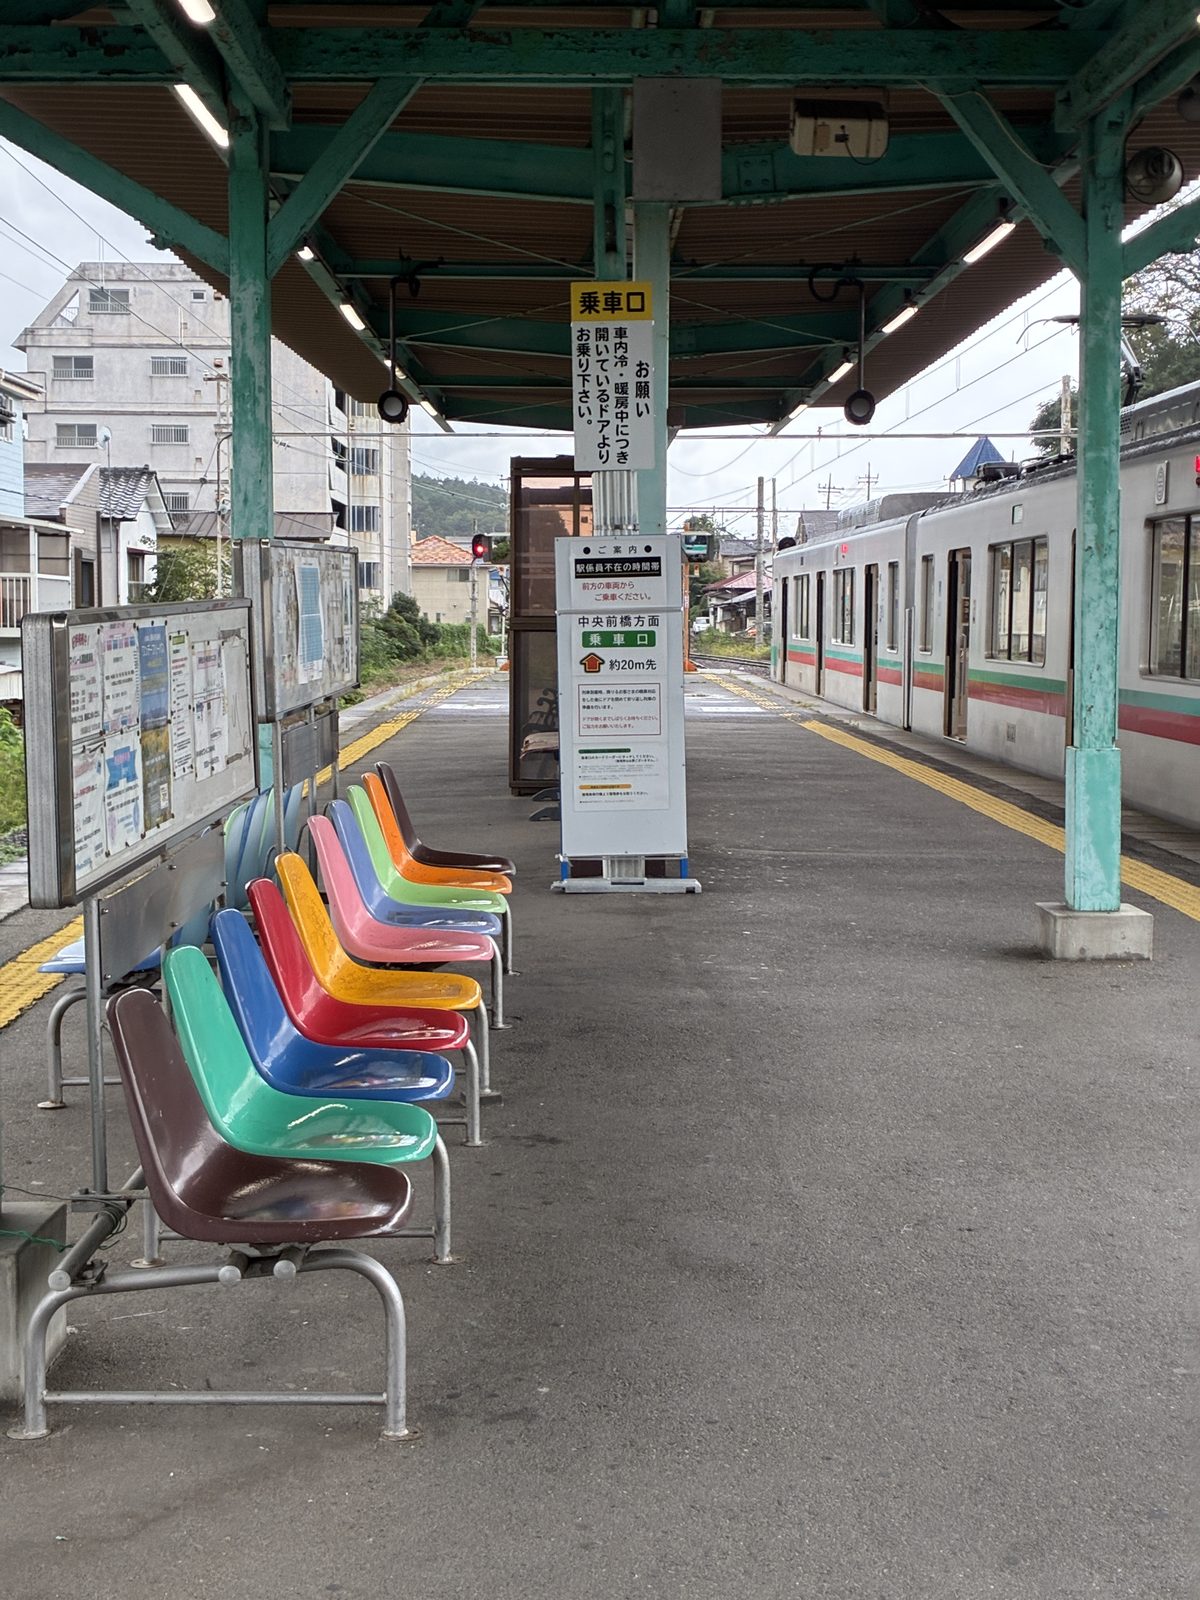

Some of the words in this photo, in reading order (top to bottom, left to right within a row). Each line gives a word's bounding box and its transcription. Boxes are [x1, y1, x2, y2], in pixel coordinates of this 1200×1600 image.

[579, 291, 645, 315] 乗車口
[576, 327, 592, 426] お乗り下さい。
[613, 326, 630, 465] 車内冷・暖房中につき
[635, 360, 650, 418] お願い
[595, 327, 611, 465] 開いているドアより
[598, 545, 638, 555] ご案内
[576, 562, 660, 573] 駅係員不在の時間帯
[582, 581, 635, 591] 前方の車両から
[594, 592, 652, 602] ご乗車ください。
[578, 614, 660, 628] 中央前橋方面
[589, 633, 649, 646] 乗車口
[609, 659, 657, 671] 約20m先
